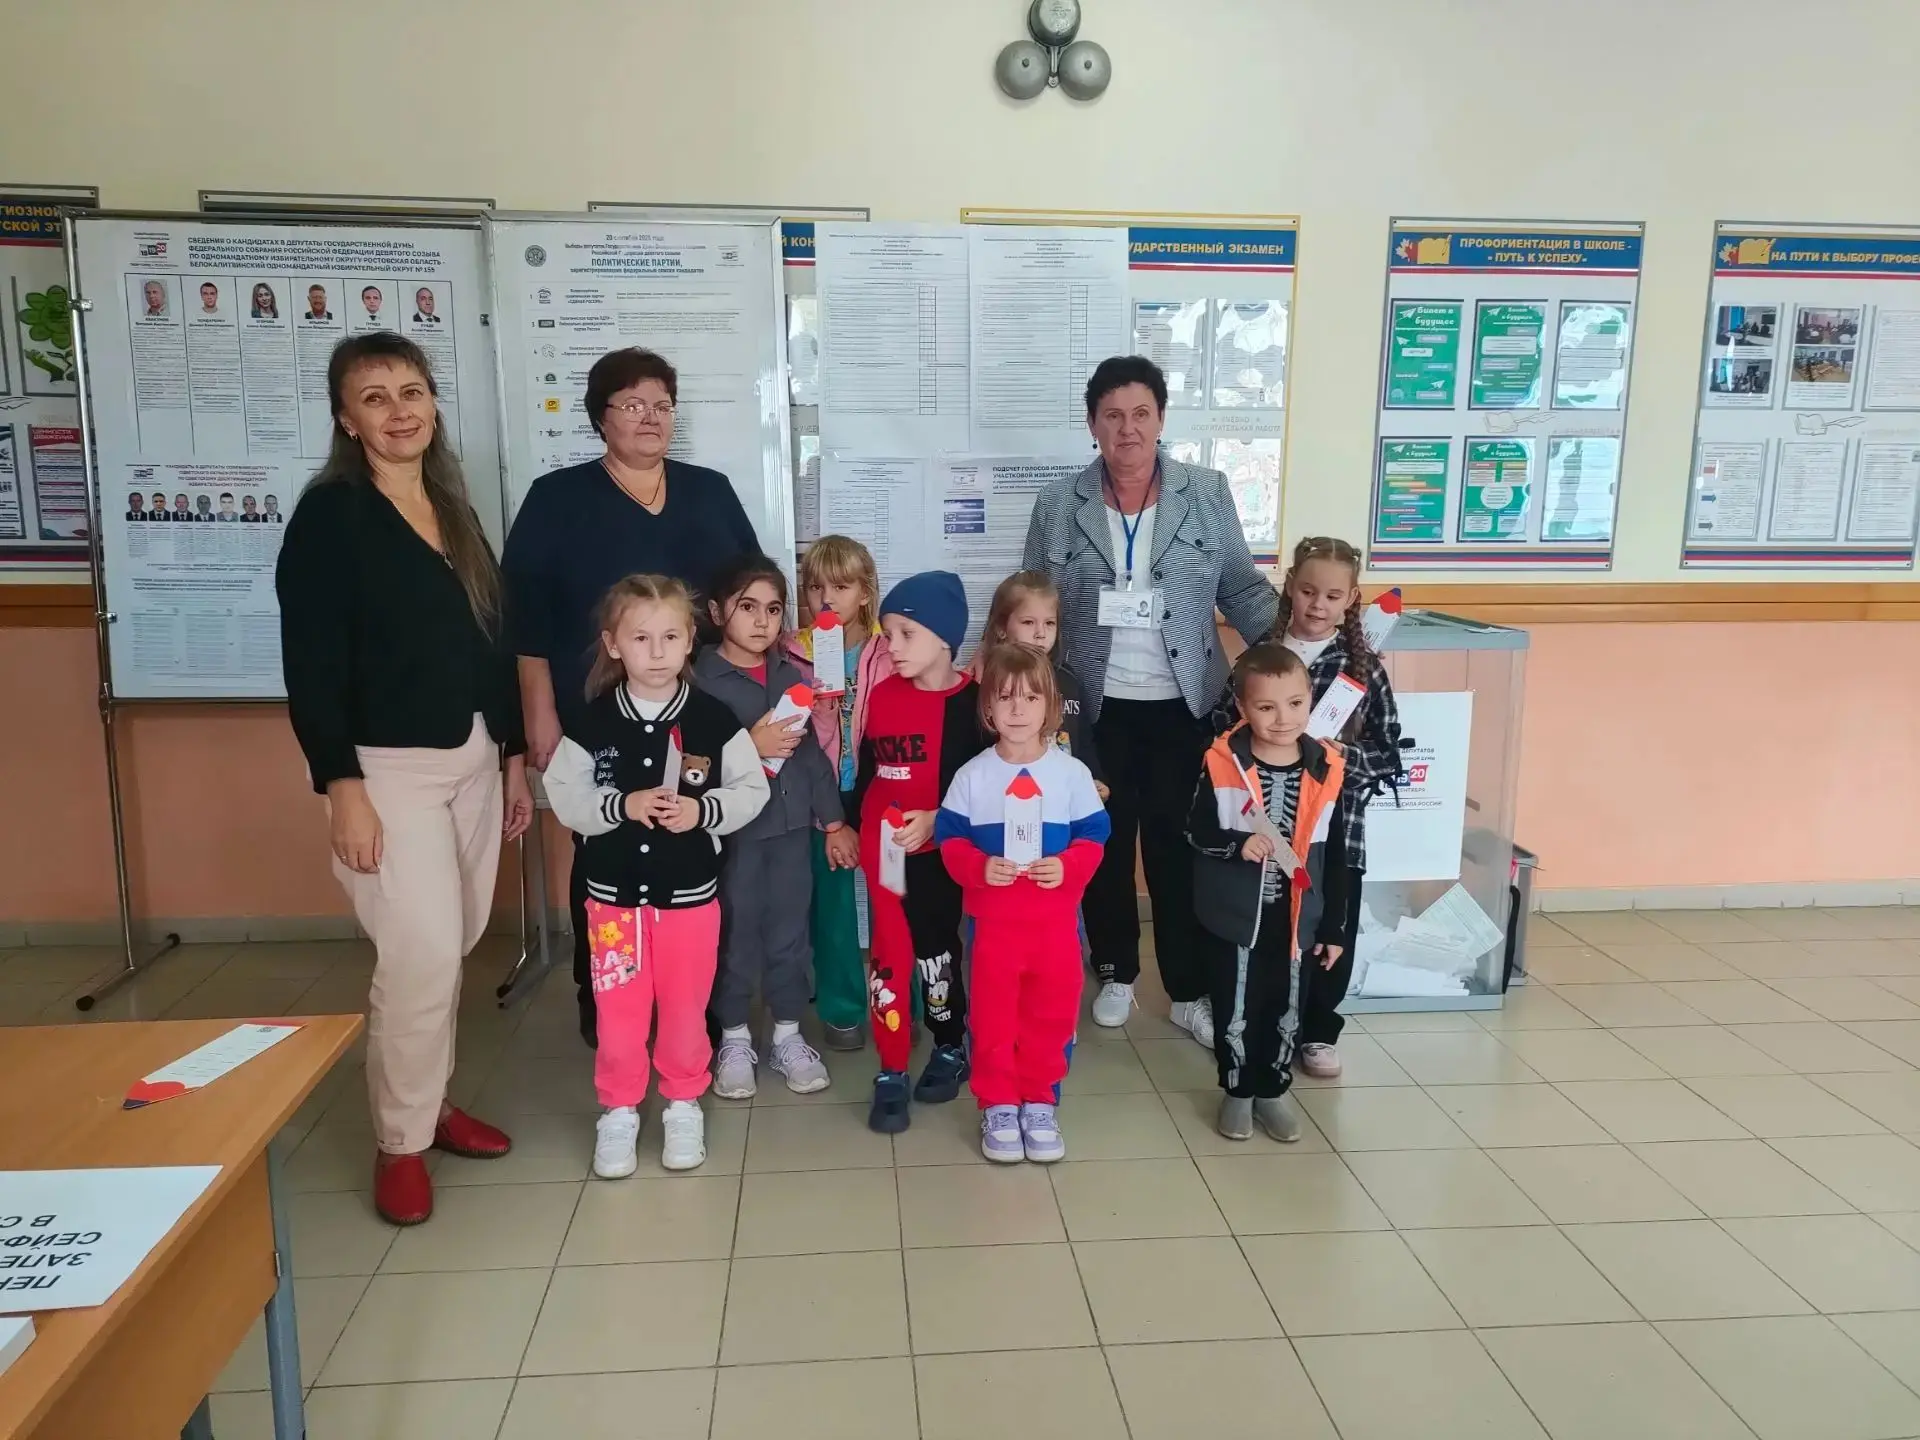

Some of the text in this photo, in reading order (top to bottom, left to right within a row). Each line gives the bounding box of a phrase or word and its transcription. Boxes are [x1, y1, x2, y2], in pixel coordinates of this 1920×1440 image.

[0, 220, 40, 231] СКОЙ
[187, 237, 225, 245] СВЕДЕНИЯ
[232, 238, 279, 246] КАНДИДАТАХ
[323, 240, 392, 248] ГОСУДАРСТВЕННОЙ
[1460, 238, 1571, 250] ПРОФОРИЕНТАЦИЯ
[1573, 240, 1581, 249] В
[1584, 240, 1626, 250] ШКОЛЕ
[188, 245, 245, 253] ФЕДЕРАЛЬНОГО
[245, 246, 283, 254] СОБРАНИЯ
[331, 248, 374, 256] ФЕДЕРАЦИИ
[375, 249, 411, 257] ДЕВЯТОГО
[1228, 244, 1284, 255] ЭКЗАМЕН
[200, 253, 269, 261] ОДНОМАНДАТНОМУ
[270, 254, 334, 262] ИЗБИРАТЕЛЬНОМУ
[1527, 253, 1536, 262] К
[1771, 251, 1920, 264] НА ПУТИ К ВЫБОРУ ПРОФЕ
[266, 262, 331, 270] ОДНОМАНДАТНЫЙ
[331, 263, 391, 272] ИЗБИРАТЕЛЬНЫЙ
[391, 265, 414, 273] ОКРУГ
[591, 259, 683, 268] ПОЛИТИЧЕСКИЕ ПАРТИИ,
[1410, 768, 1425, 779] 20
[30, 1214, 57, 1227] В
